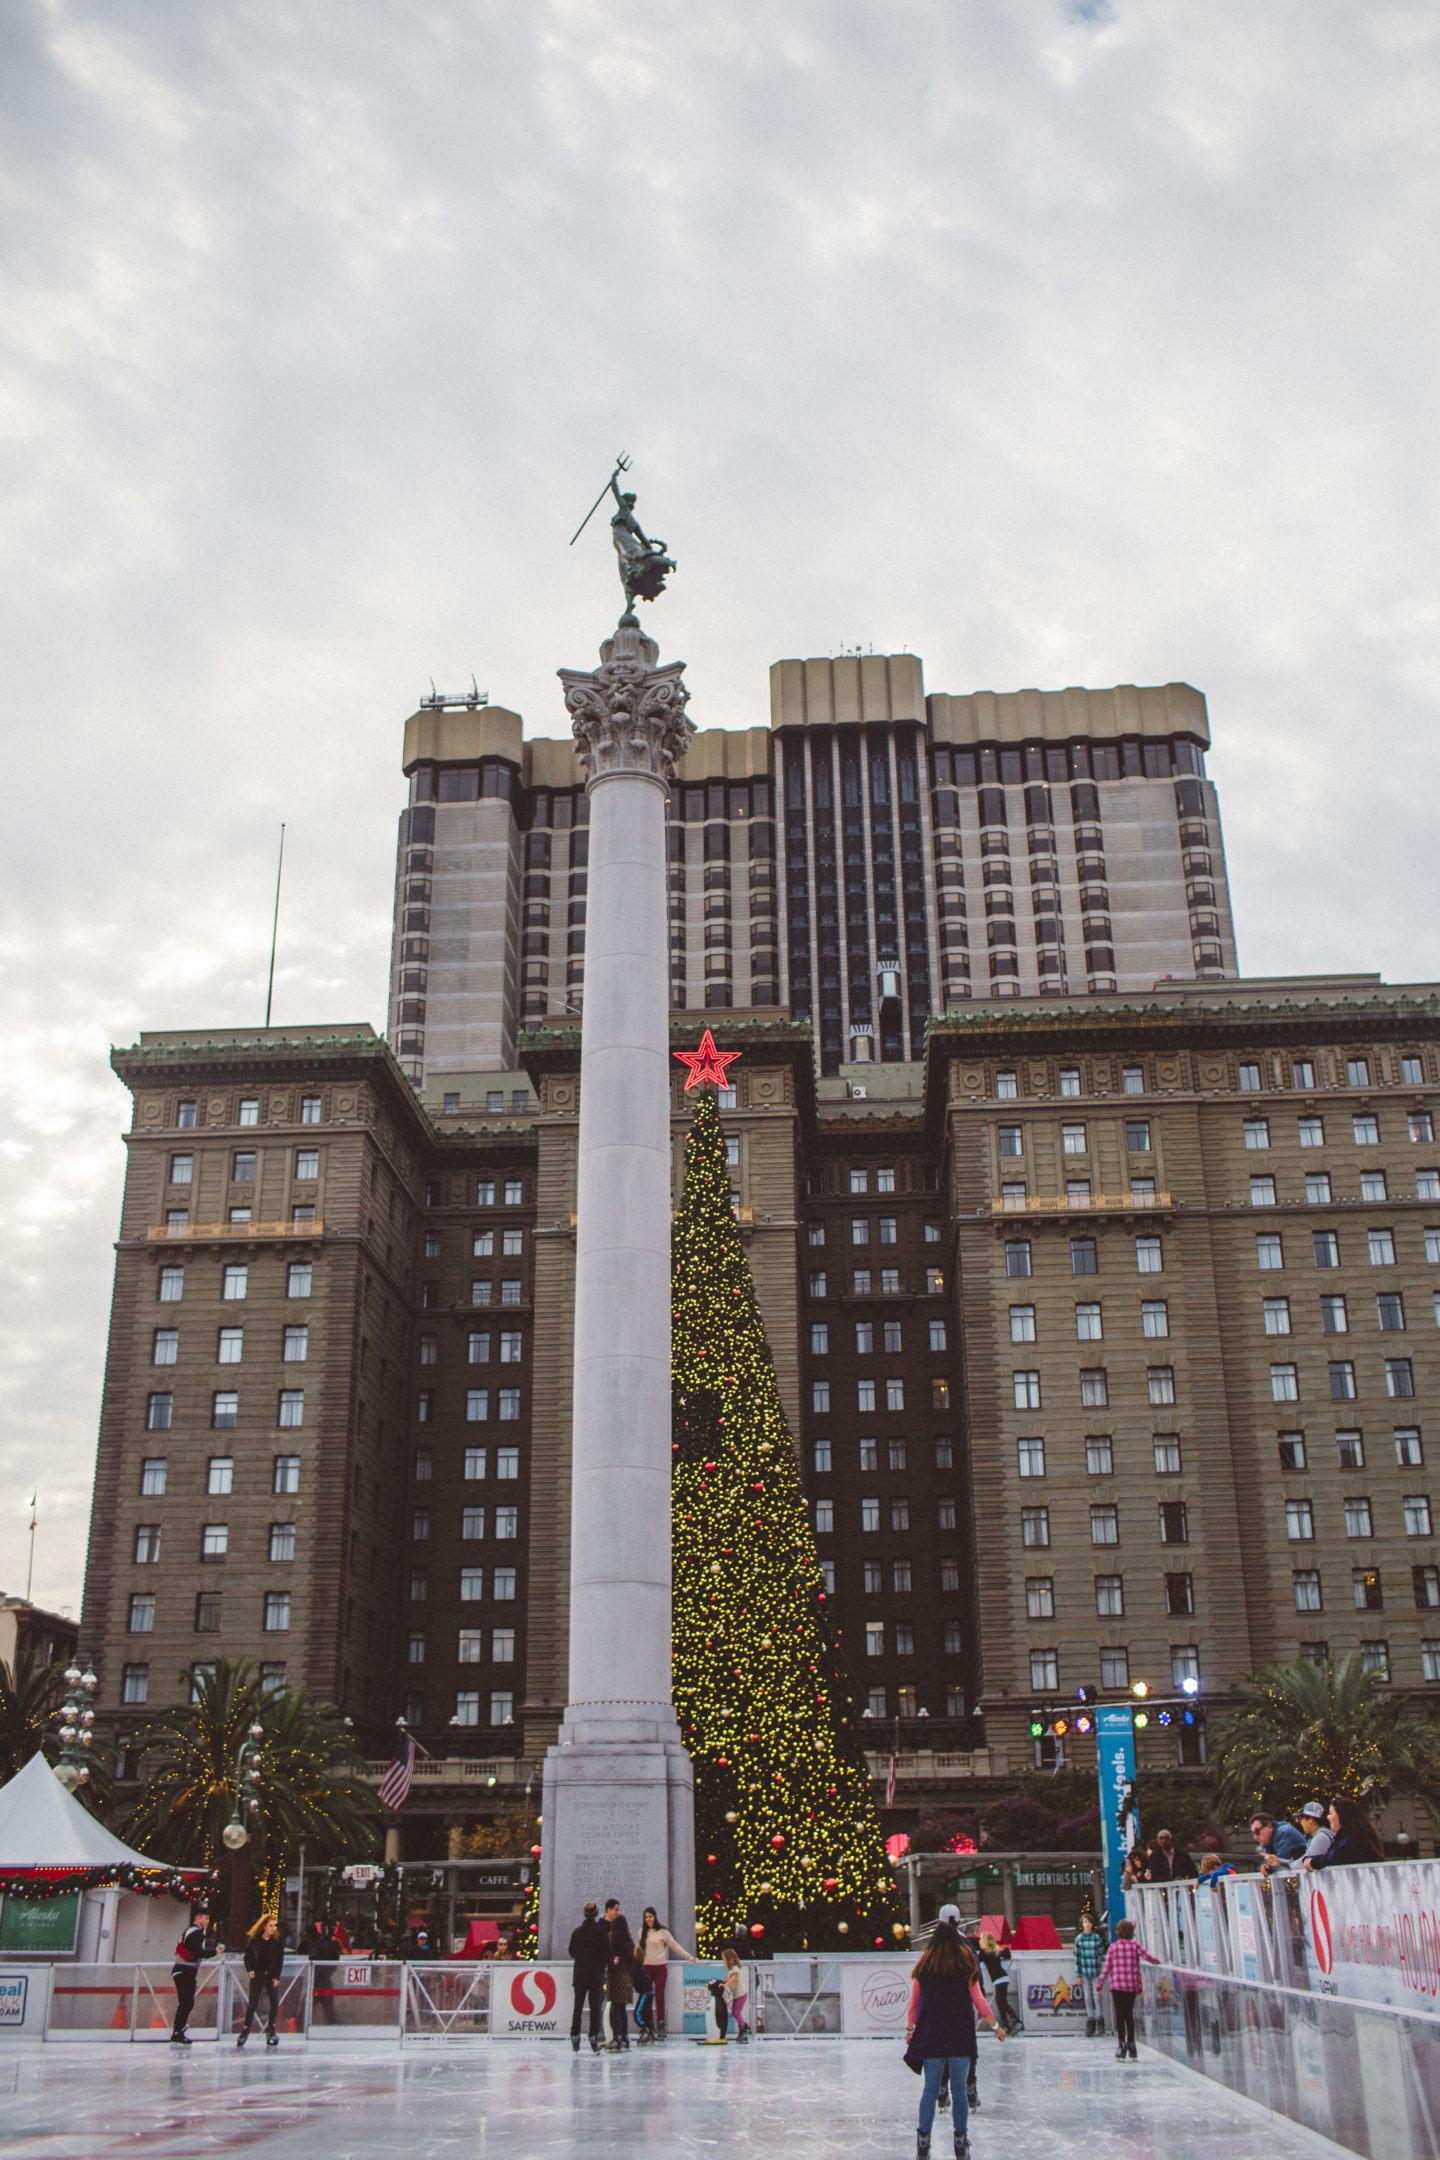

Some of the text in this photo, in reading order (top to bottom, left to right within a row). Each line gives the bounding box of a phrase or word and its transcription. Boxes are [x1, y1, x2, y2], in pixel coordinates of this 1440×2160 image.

[356, 1867, 370, 1878] EXIT
[480, 1876, 509, 1885] CAFFE
[1017, 1873, 1035, 1886] BIKE
[1036, 1873, 1071, 1886] RENTALS
[19, 1907, 60, 1920] Alaska
[347, 1967, 368, 1983] EXIT
[862, 1982, 910, 2010] Triton
[684, 2000, 703, 2011] ICE
[508, 2021, 557, 2031] SAFEWAY
